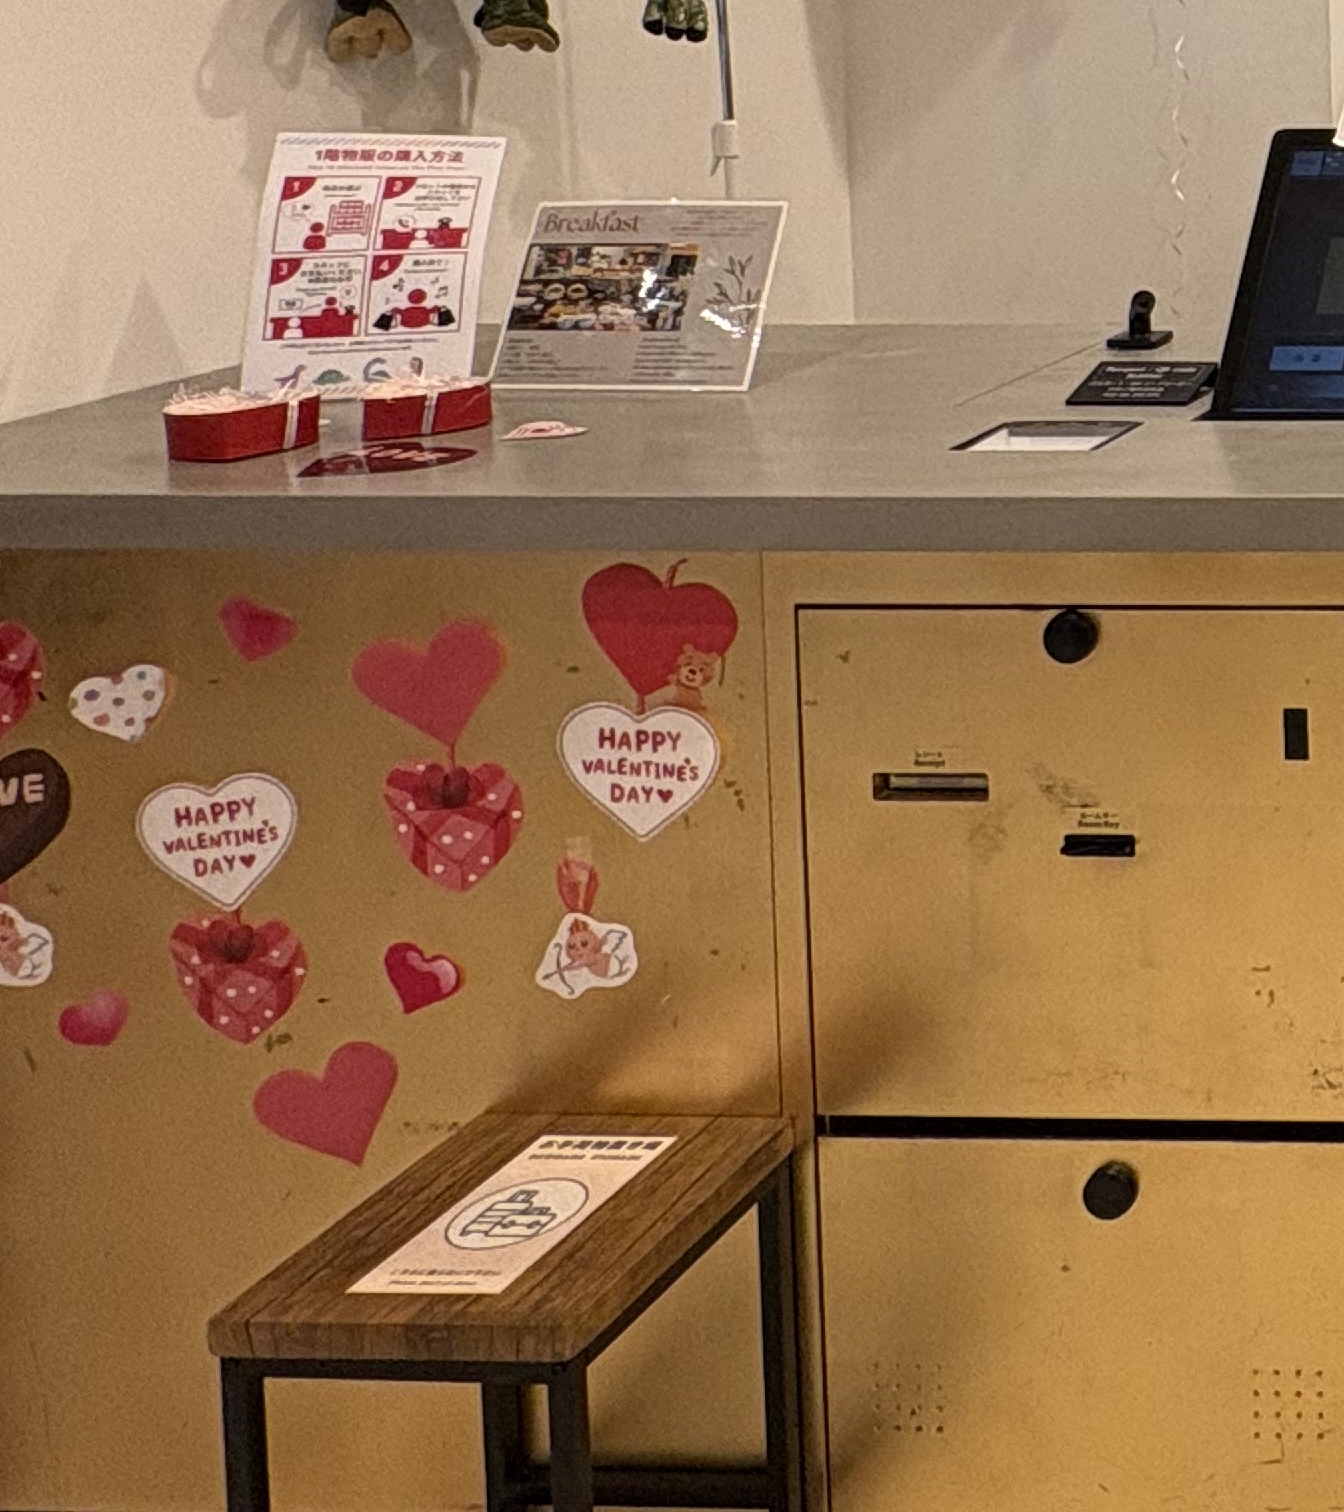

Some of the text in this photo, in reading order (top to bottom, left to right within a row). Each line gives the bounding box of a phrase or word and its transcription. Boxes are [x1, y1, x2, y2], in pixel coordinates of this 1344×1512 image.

[292, 180, 300, 192] 1
[393, 180, 402, 192] 2
[543, 210, 640, 235] Breakfast
[278, 262, 288, 276] 3
[379, 259, 390, 272] 4
[598, 726, 682, 753] HAPPY
[581, 757, 700, 782] VALENTINE'S
[610, 782, 654, 804] DAY
[174, 796, 256, 829] HAPPY
[162, 819, 280, 855] VALENTINE'S
[193, 854, 236, 878] DAY
